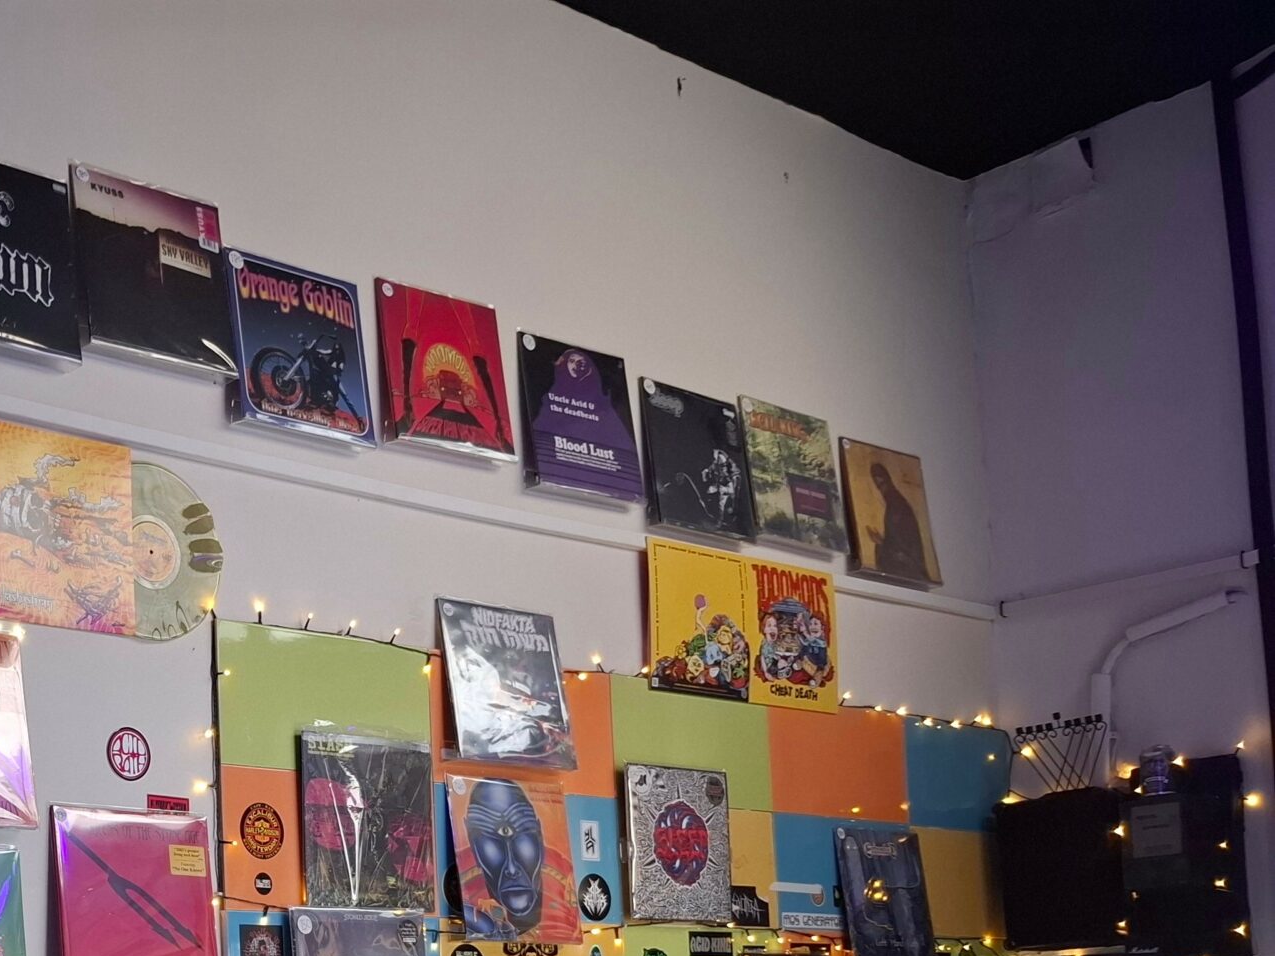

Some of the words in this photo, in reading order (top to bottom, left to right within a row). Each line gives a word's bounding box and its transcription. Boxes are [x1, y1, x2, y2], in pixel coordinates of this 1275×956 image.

[90, 183, 124, 199] KYUSS
[161, 243, 179, 258] SKY
[179, 247, 209, 269] VALLEY
[239, 267, 299, 314] Orange
[302, 279, 356, 330] Goblin
[548, 392, 570, 405] Uncle
[571, 397, 588, 408] Acid
[550, 403, 563, 413] the
[564, 406, 600, 422] deadbeats
[554, 435, 589, 455] Blood
[590, 442, 615, 461] Lust
[769, 682, 793, 697] CHEAT
[794, 686, 817, 701] DEATH
[691, 935, 711, 953] ACID
[711, 936, 732, 953] KING
